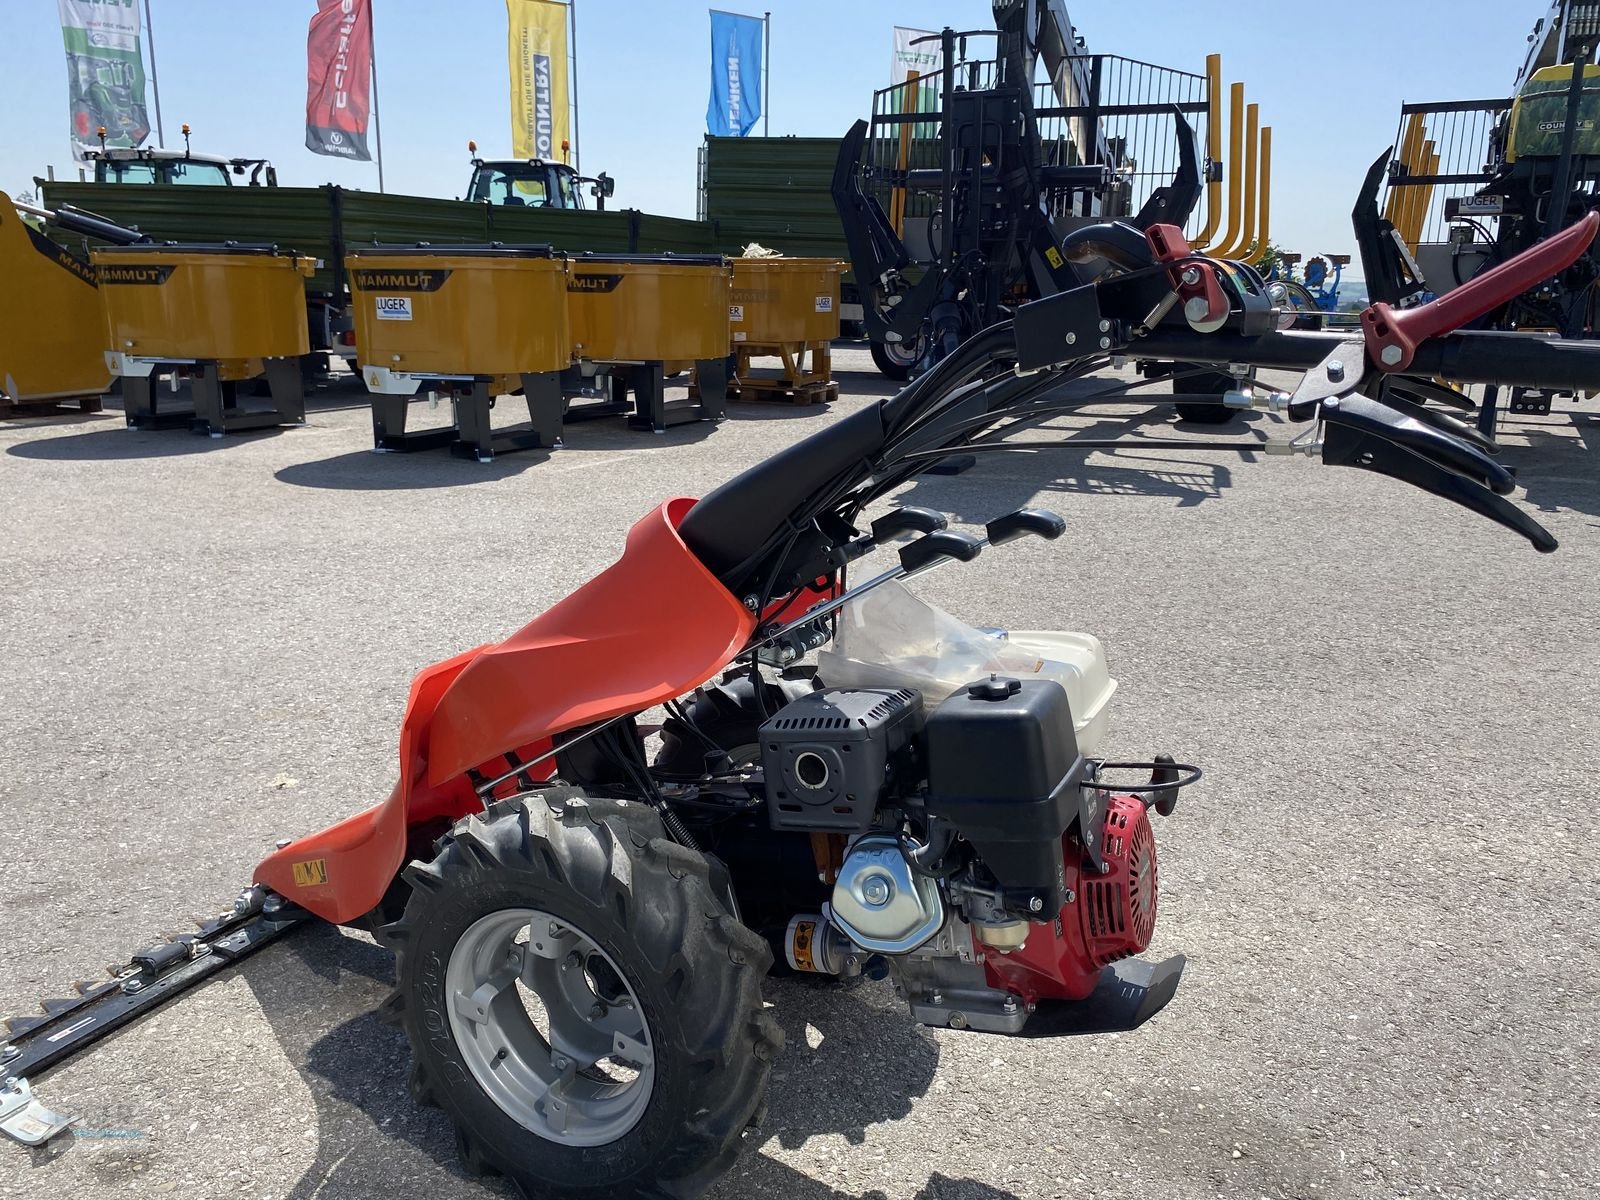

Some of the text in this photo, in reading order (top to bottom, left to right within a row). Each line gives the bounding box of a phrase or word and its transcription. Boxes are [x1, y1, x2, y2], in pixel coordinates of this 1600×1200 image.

[1460, 195, 1497, 206] LUGER
[98, 270, 159, 280] MAMMUT
[358, 275, 432, 286] MAMMUT
[377, 298, 406, 310] LUGER
